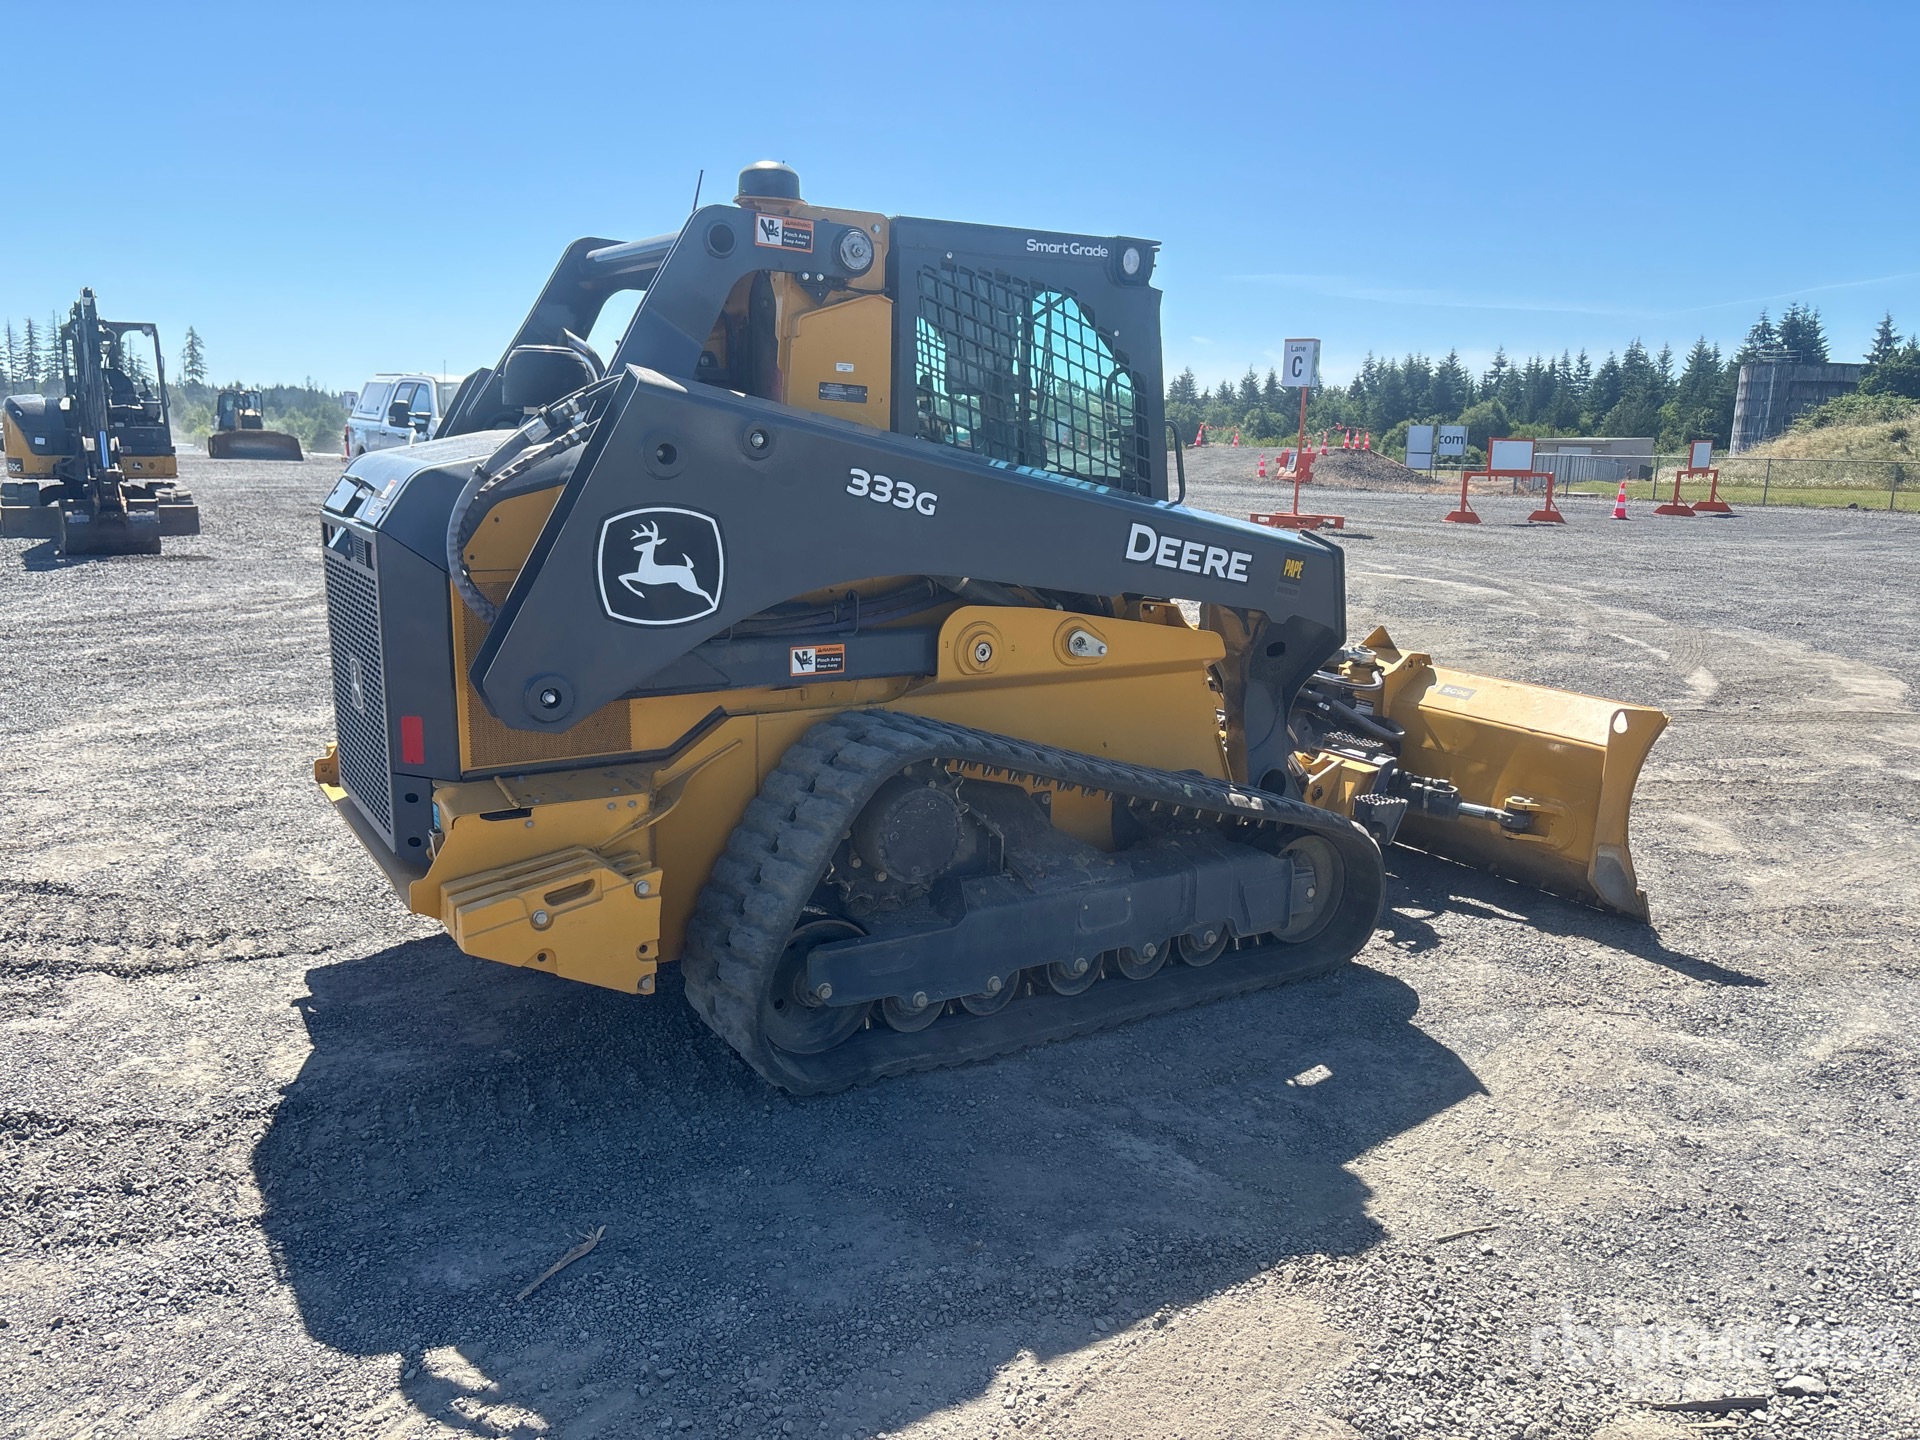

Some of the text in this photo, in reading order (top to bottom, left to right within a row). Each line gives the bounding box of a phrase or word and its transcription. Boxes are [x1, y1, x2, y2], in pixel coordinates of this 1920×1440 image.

[1291, 355, 1303, 378] C
[846, 468, 938, 516] 333G
[1125, 522, 1253, 583] DEERE
